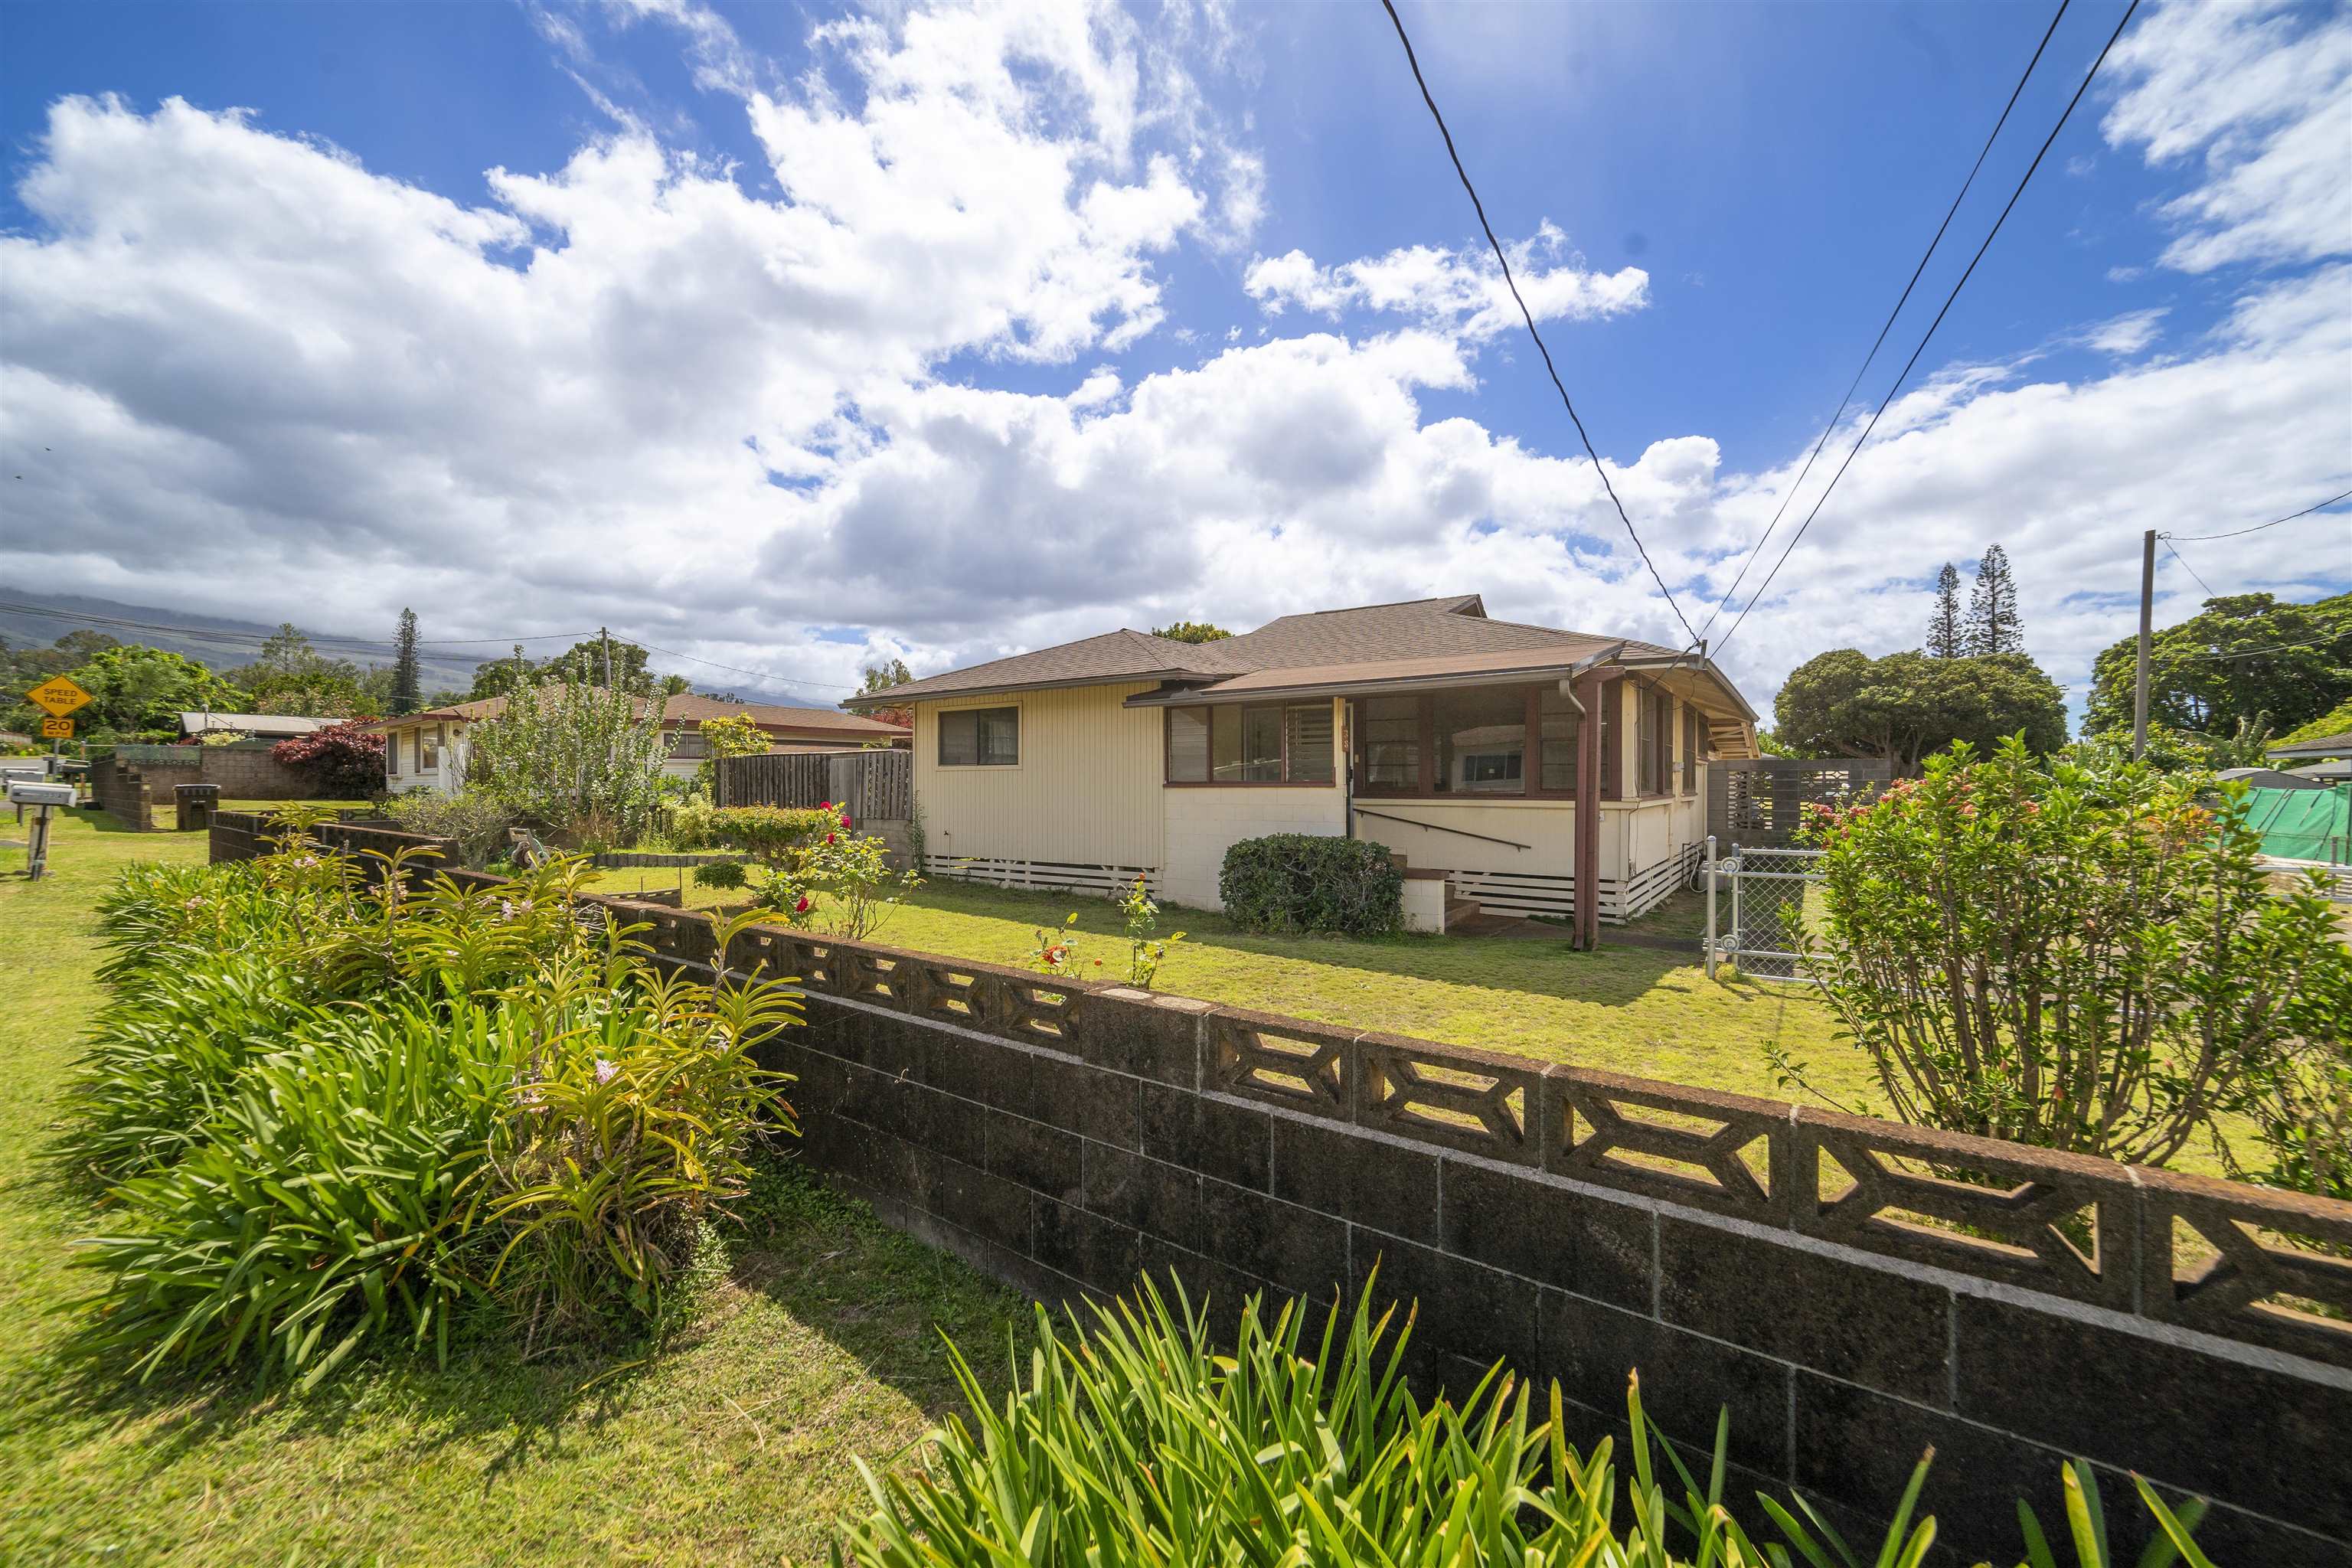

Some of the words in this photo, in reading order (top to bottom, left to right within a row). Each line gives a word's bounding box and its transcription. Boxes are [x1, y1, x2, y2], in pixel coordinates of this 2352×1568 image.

[43, 688, 77, 697] SPEED
[43, 696, 77, 704] TABLE
[46, 720, 70, 730] 20
